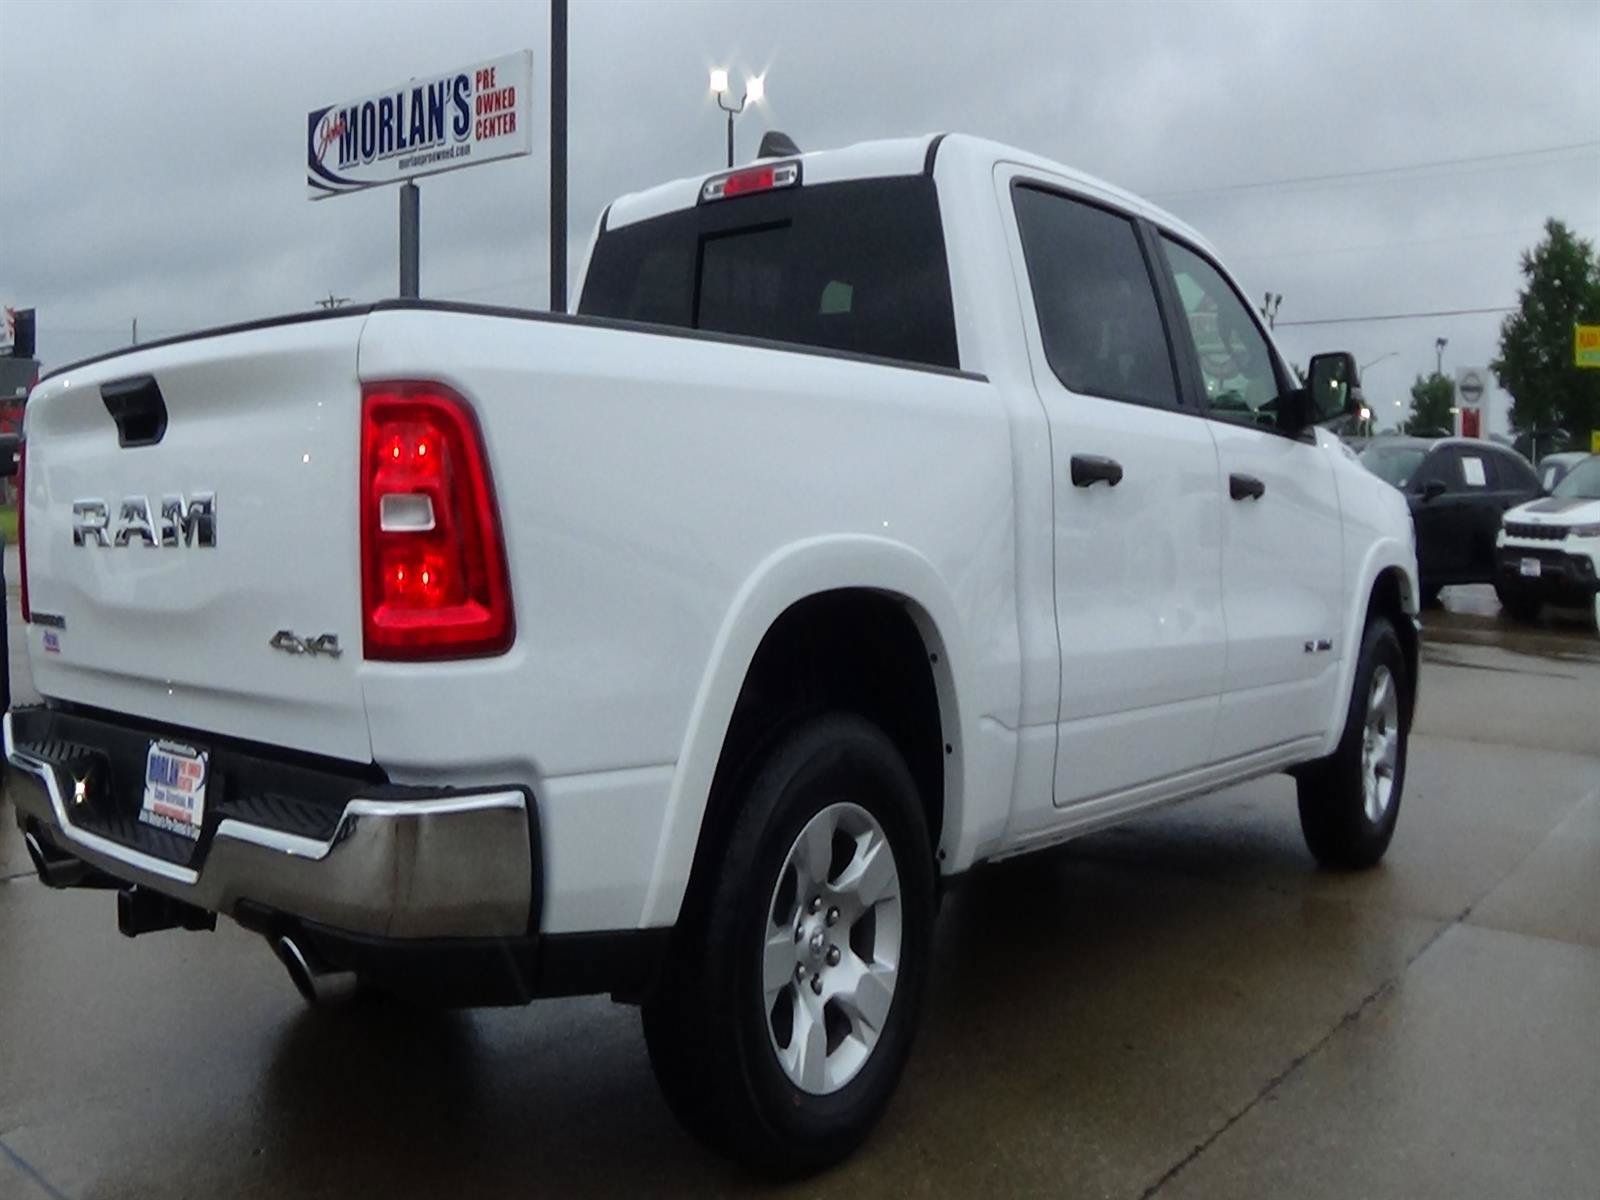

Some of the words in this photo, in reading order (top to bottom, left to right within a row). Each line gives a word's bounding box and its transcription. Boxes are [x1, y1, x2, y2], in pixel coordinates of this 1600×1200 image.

[476, 66, 496, 93] PRE
[476, 86, 516, 117] OWNED
[338, 73, 472, 166] MORLAN'S
[475, 112, 517, 142] CENTER
[72, 491, 217, 548] RAM
